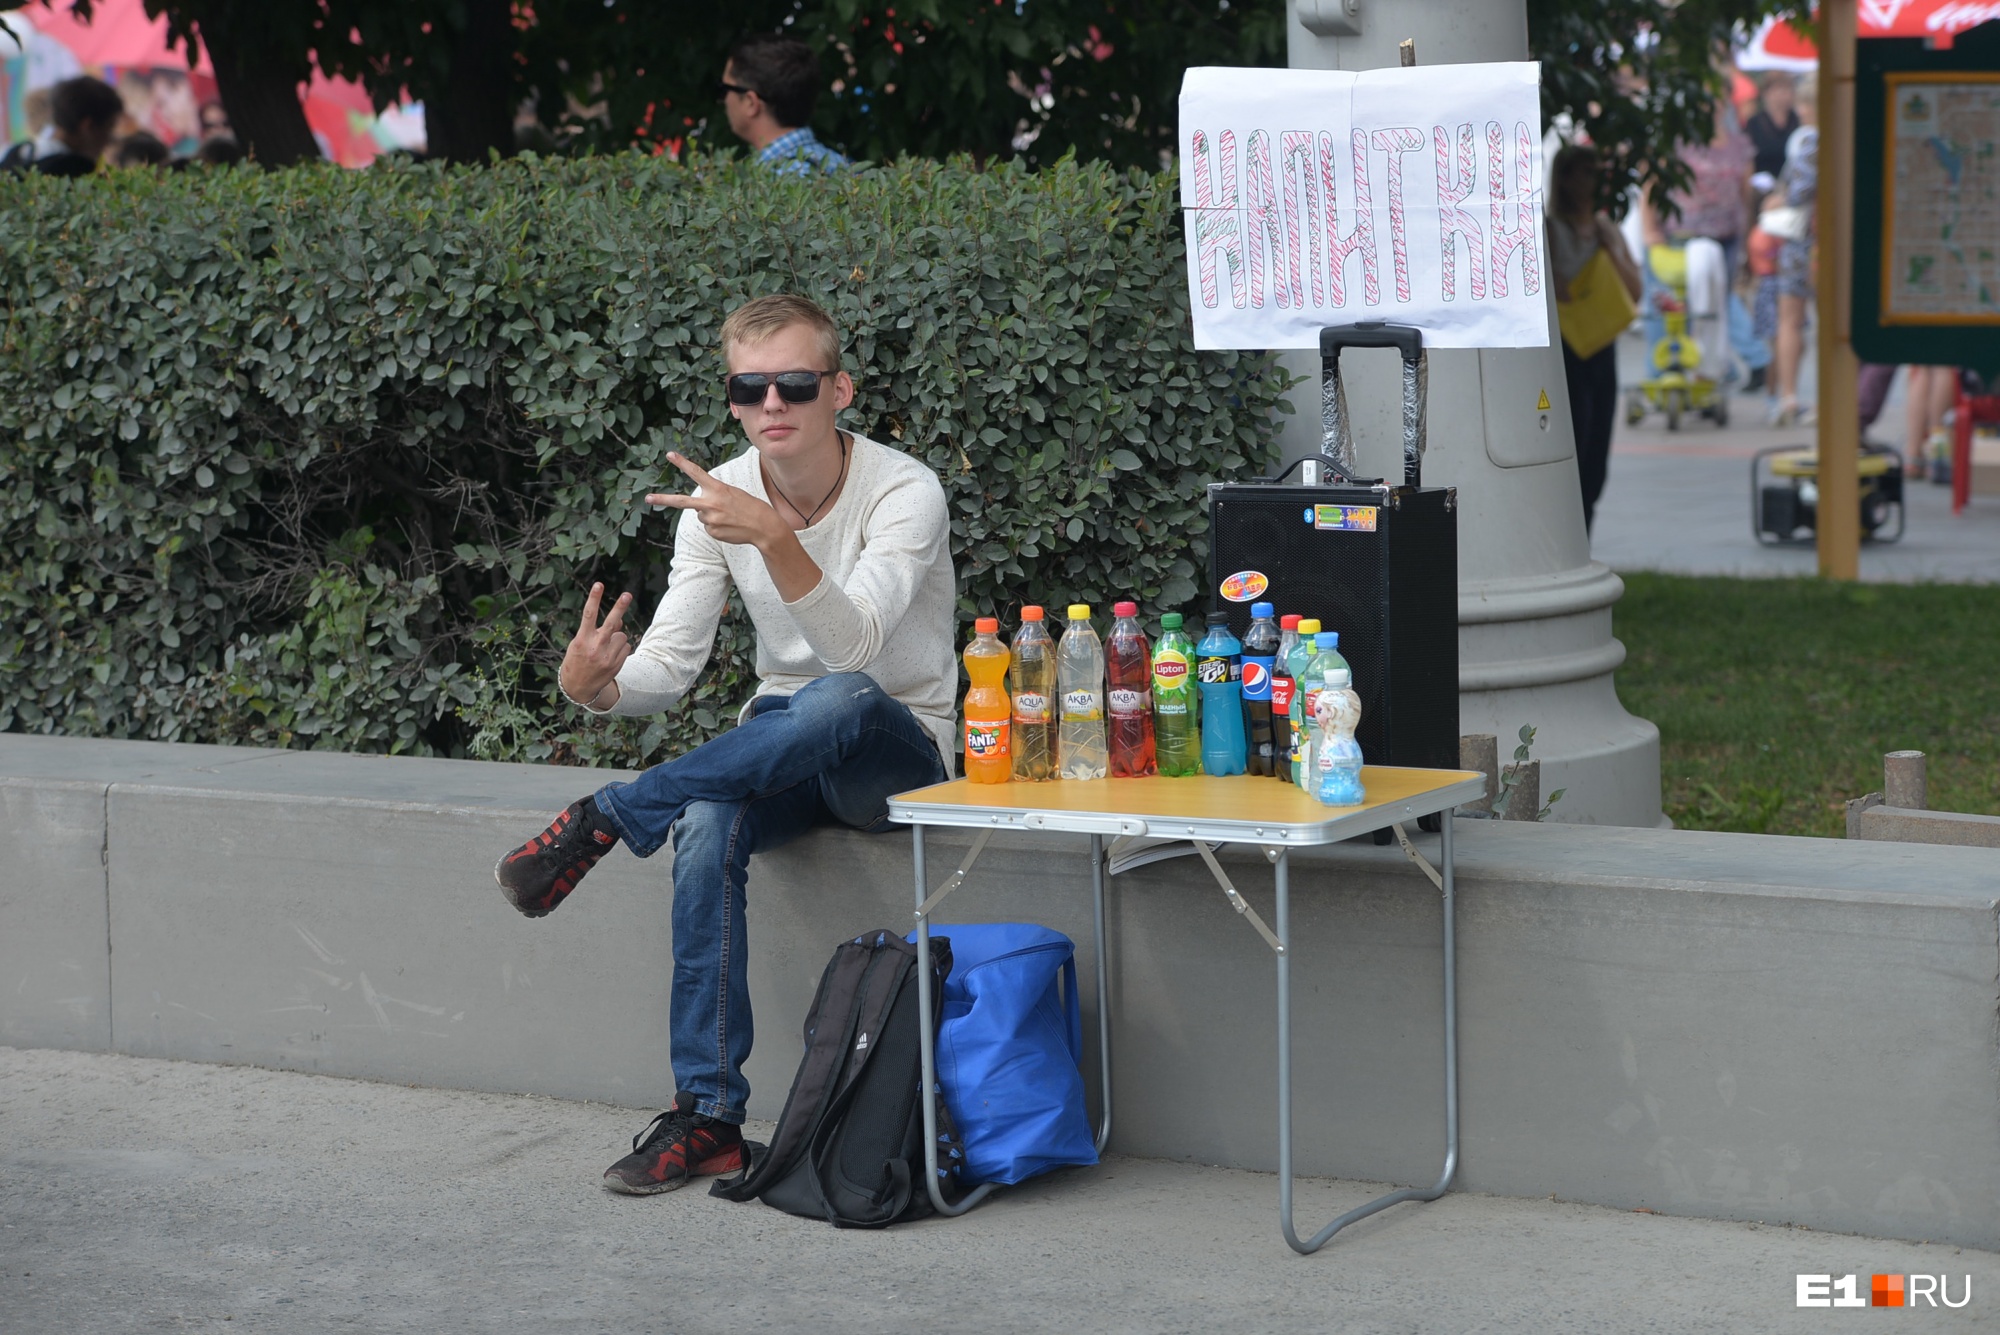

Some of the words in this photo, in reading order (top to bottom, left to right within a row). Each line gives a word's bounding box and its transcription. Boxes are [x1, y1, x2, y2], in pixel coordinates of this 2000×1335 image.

[1193, 121, 1540, 309] НАПИТКИ
[1156, 664, 1184, 675] Lipton
[1019, 697, 1043, 707] AQUA
[1067, 694, 1093, 705] АКВА
[1112, 692, 1136, 703] АКВА
[968, 733, 997, 747] FANTA
